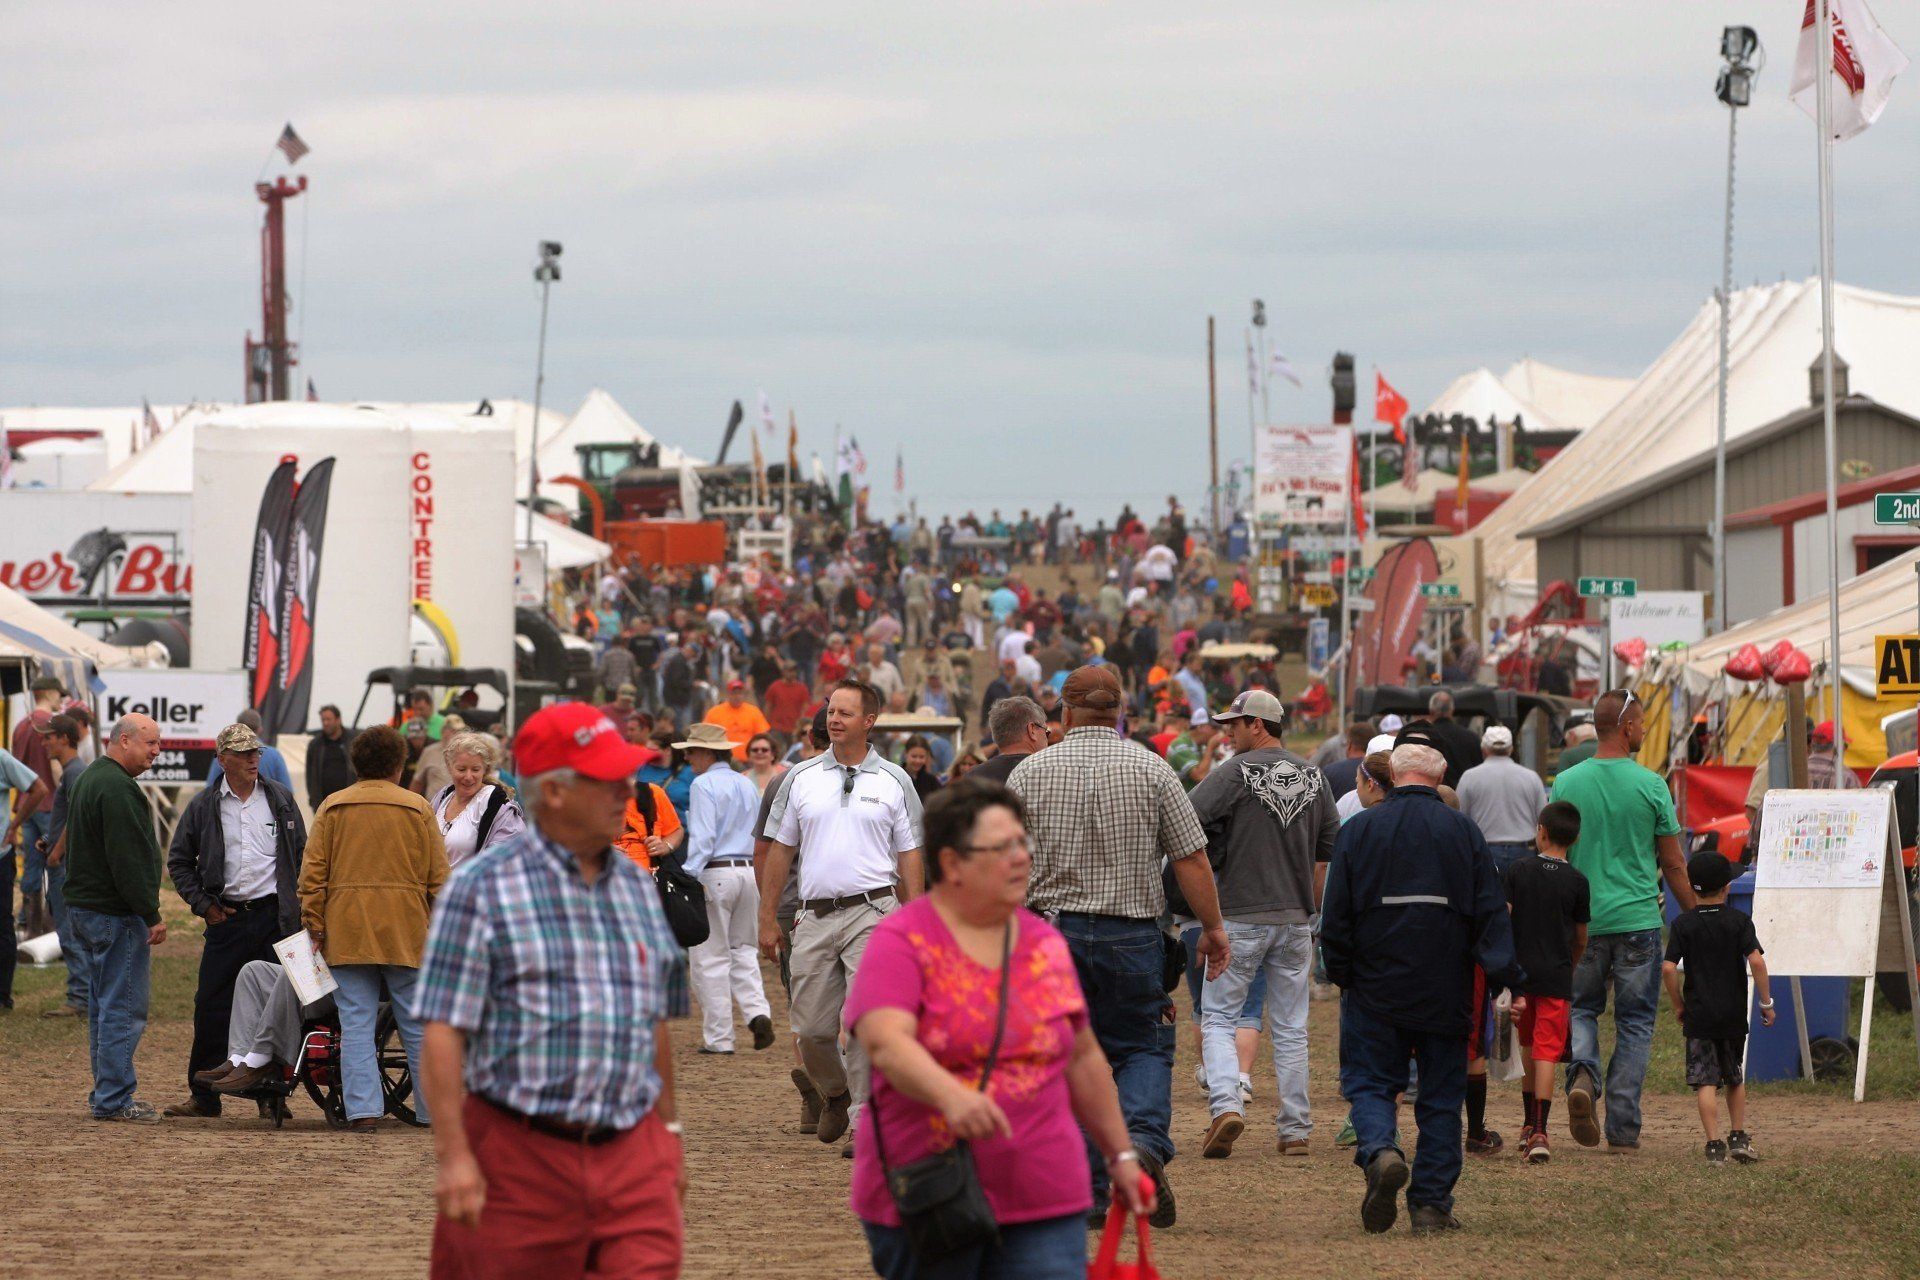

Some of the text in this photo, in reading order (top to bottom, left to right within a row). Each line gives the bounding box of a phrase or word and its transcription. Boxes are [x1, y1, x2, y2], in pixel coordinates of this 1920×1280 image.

[1893, 498, 1920, 519] 2nd
[412, 452, 433, 602] CONTREE
[1590, 580, 1606, 595] 3rd
[1619, 602, 1673, 619] Welcome
[107, 696, 204, 723] Keller
